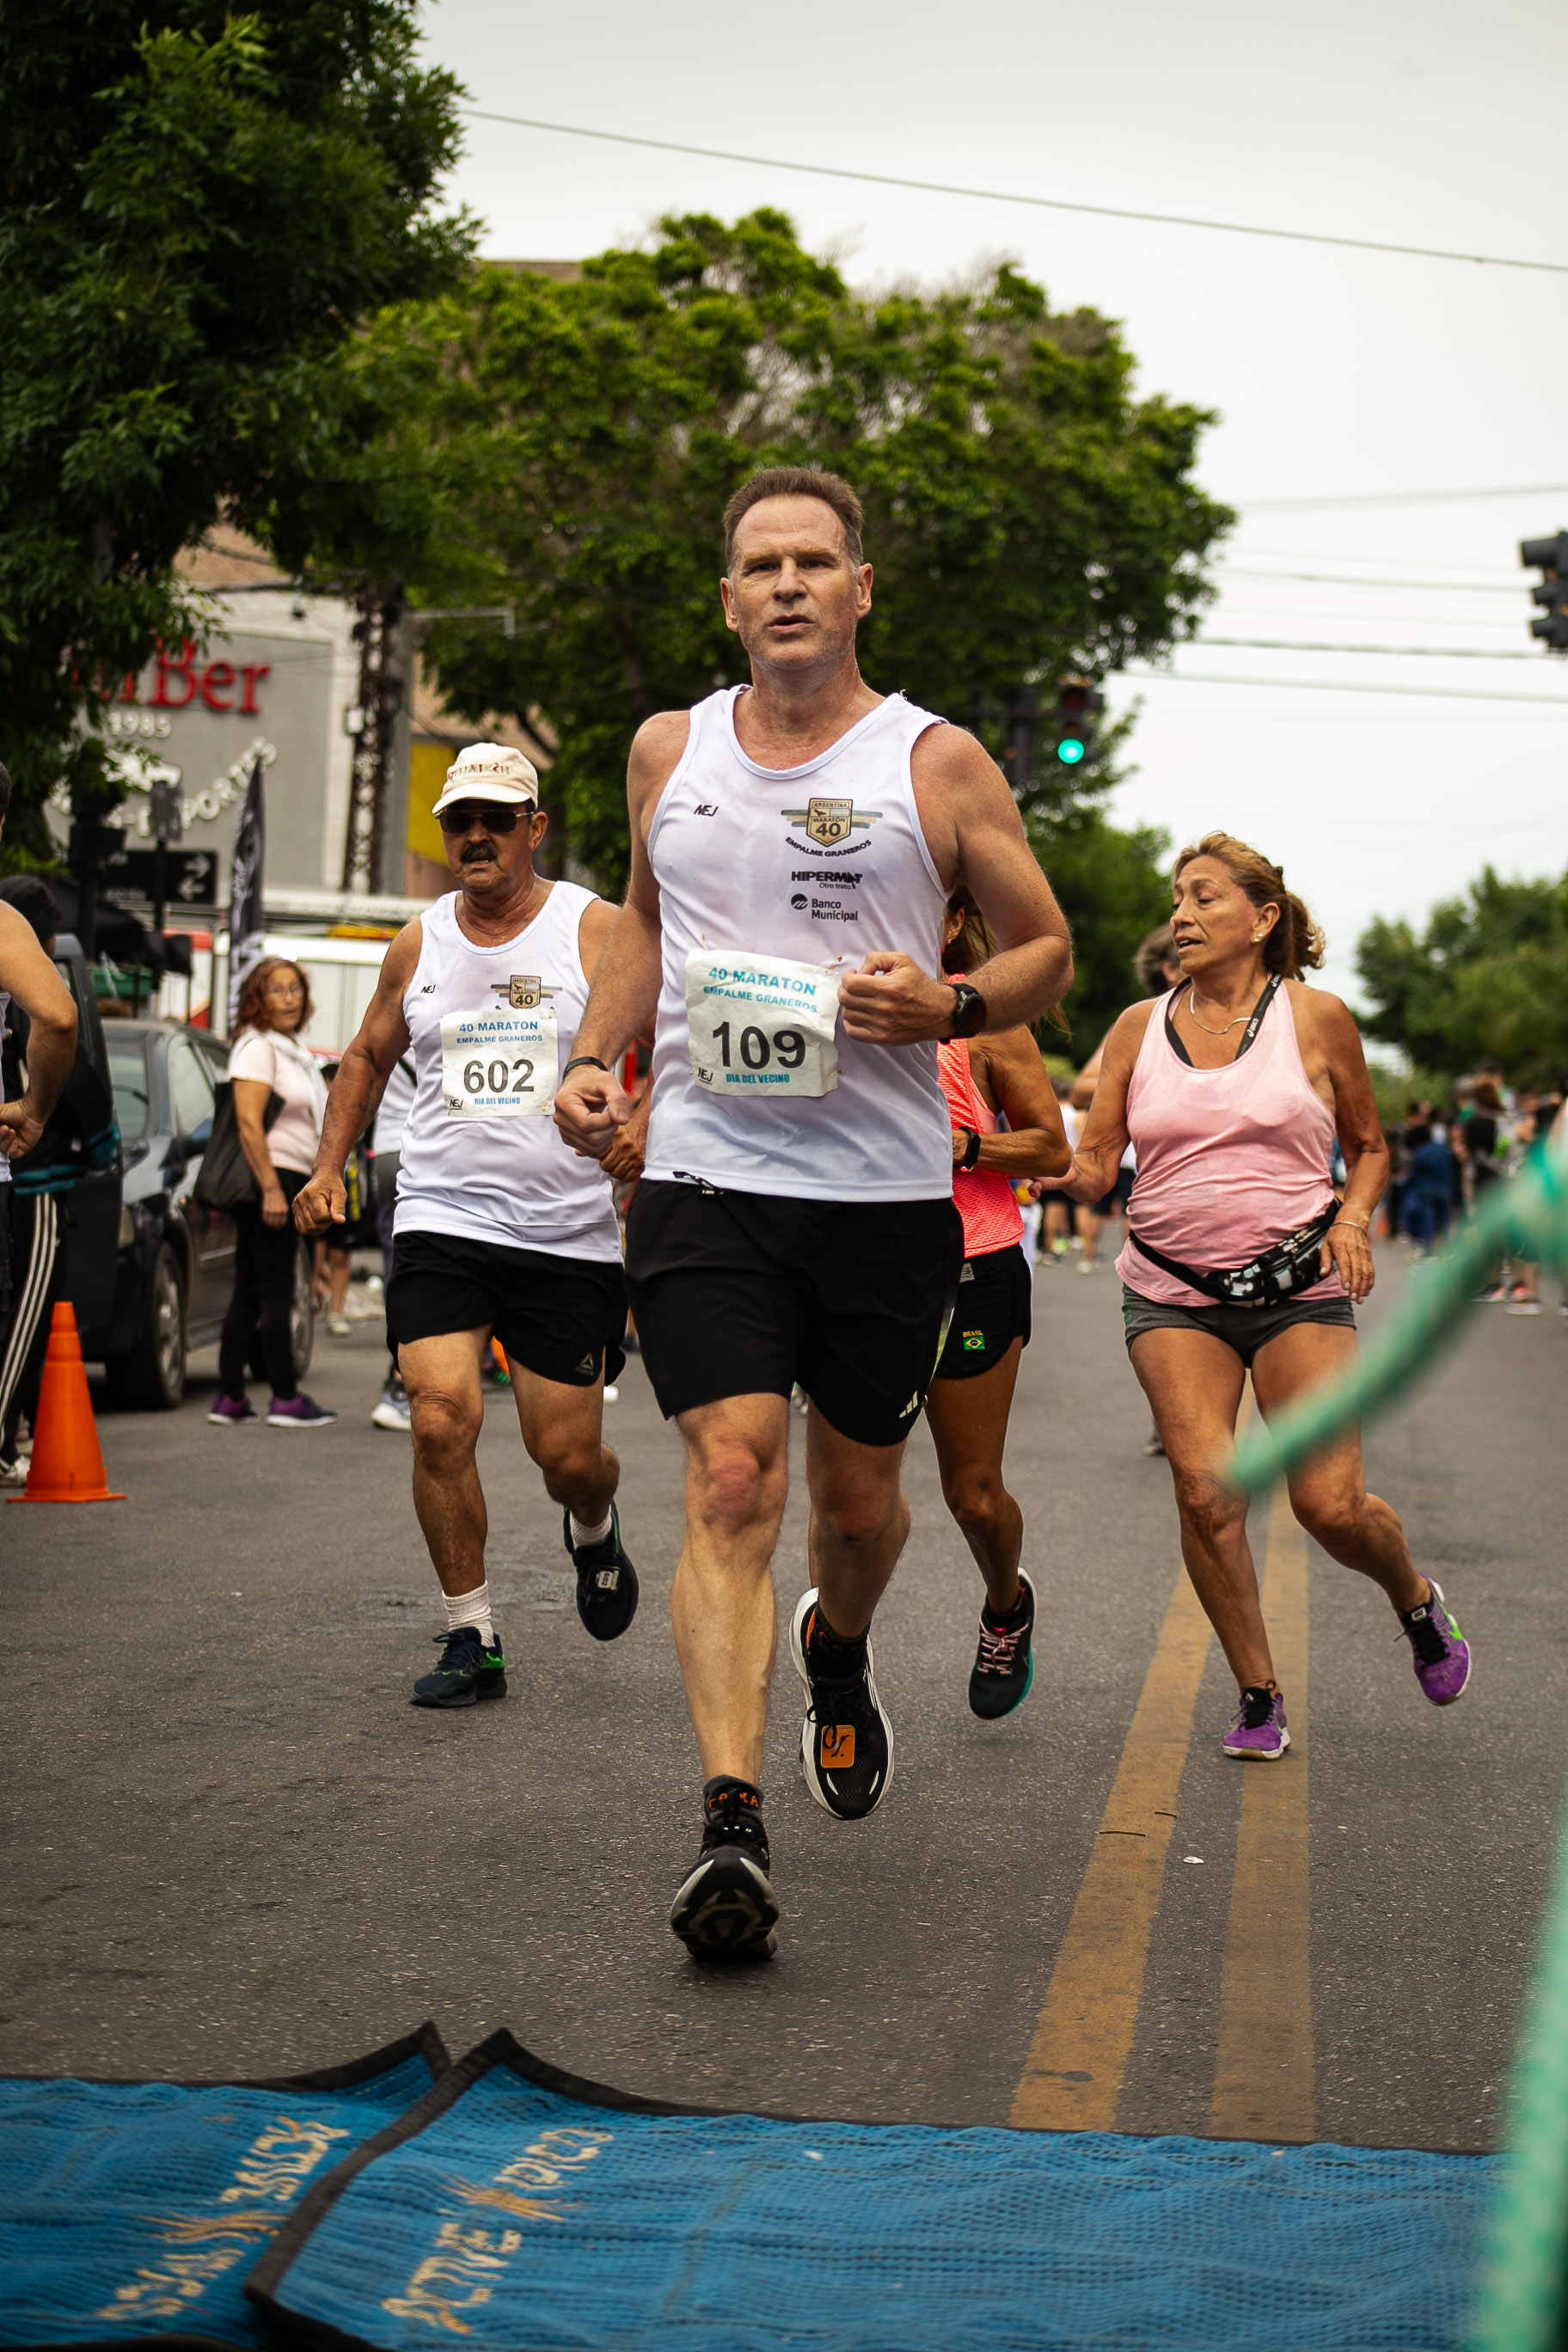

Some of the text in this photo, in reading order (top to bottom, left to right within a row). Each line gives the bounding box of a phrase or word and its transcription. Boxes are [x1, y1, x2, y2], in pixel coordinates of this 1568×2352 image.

[108, 710, 172, 738] 1985
[694, 805, 720, 817] NEJ
[816, 823, 842, 836] 40
[785, 836, 872, 857] EMPALME GRANEROS
[812, 898, 842, 909] Banco
[812, 910, 859, 922] Municipal
[708, 967, 817, 996] 40 MARATON
[420, 984, 436, 994] NEJ
[516, 995, 534, 1005] 40
[703, 986, 818, 1014] EMPALME GRANEROS
[459, 1020, 538, 1032] 40 MARATON
[712, 1021, 806, 1070] 109
[463, 1058, 535, 1093] 602
[697, 1067, 714, 1082] NEJ
[726, 1074, 741, 1083] DIA
[742, 1074, 756, 1084] DEL
[757, 1073, 790, 1083] VECINO
[450, 1099, 464, 1108] NEJ
[497, 1096, 521, 1105] VECINO
